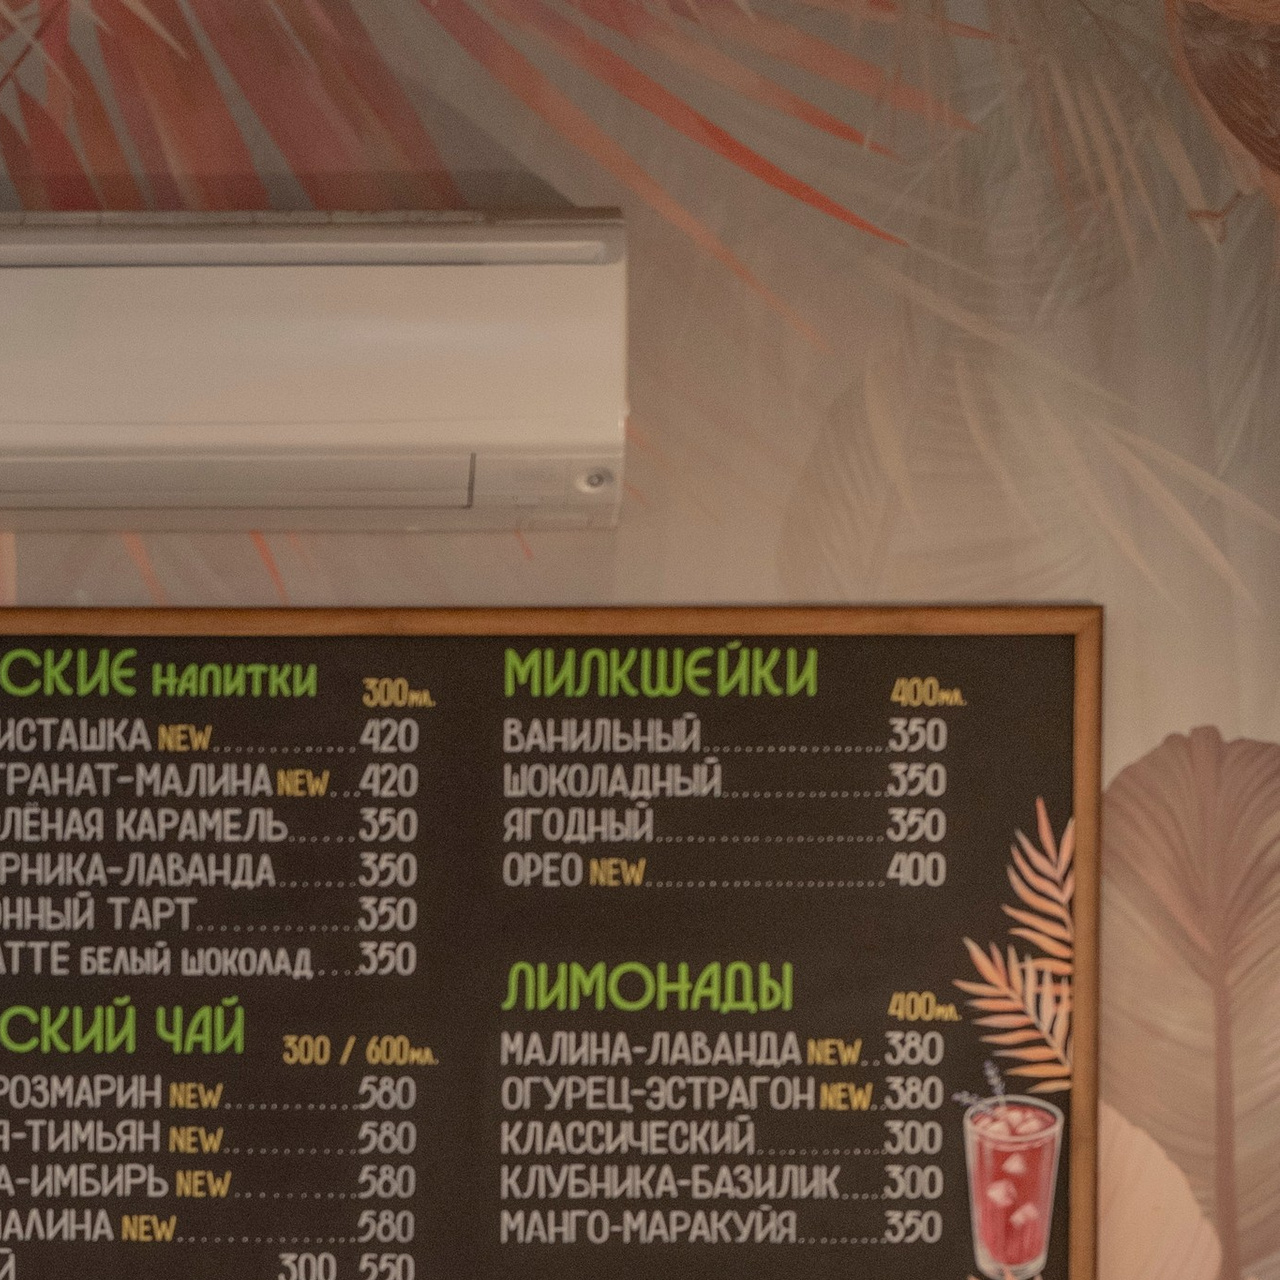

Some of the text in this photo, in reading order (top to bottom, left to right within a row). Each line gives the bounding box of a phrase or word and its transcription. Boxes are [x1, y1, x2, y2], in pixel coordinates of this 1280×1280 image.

[505, 642, 817, 697] МИЛКШЕЙКИ
[360, 718, 419, 753] 420
[503, 712, 947, 752] ВАНИЛЬНЫЙ 350
[360, 763, 418, 797] 420
[504, 757, 946, 799] ШОКОЛАДНЫЙ 350
[117, 808, 288, 842] КАРАМЕЛЬ
[359, 808, 418, 841] 350
[504, 801, 946, 843] ЯГОДНЫЙ 350
[359, 852, 417, 887] 350
[503, 852, 946, 887] ОРЕО 400
[108, 897, 197, 930] ТАРТ
[359, 897, 417, 931] 350
[80, 941, 170, 975] БЕЛЫЙ
[182, 948, 313, 979] ШОКОЛАД
[359, 942, 416, 975] 350
[503, 962, 792, 1013] ЛИМОНАДЫ
[157, 997, 244, 1053] ЧАЙ
[501, 1031, 944, 1067] МАЛИНА-ЛАВАНДА 380
[358, 1076, 416, 1110] 580
[502, 1076, 943, 1112] ОГУРЕЦ-ЭСТРАГОН 380
[359, 1121, 416, 1154] 580
[501, 1115, 942, 1154] КЛАССИЧЕСКИЙ 300
[359, 1165, 415, 1198] 580
[501, 1164, 943, 1199] КЛУБНИКА-БАЗИЛИК 300
[358, 1210, 414, 1242] 580
[501, 1205, 942, 1244] МАНГО-МАРАКУЙЯ 350
